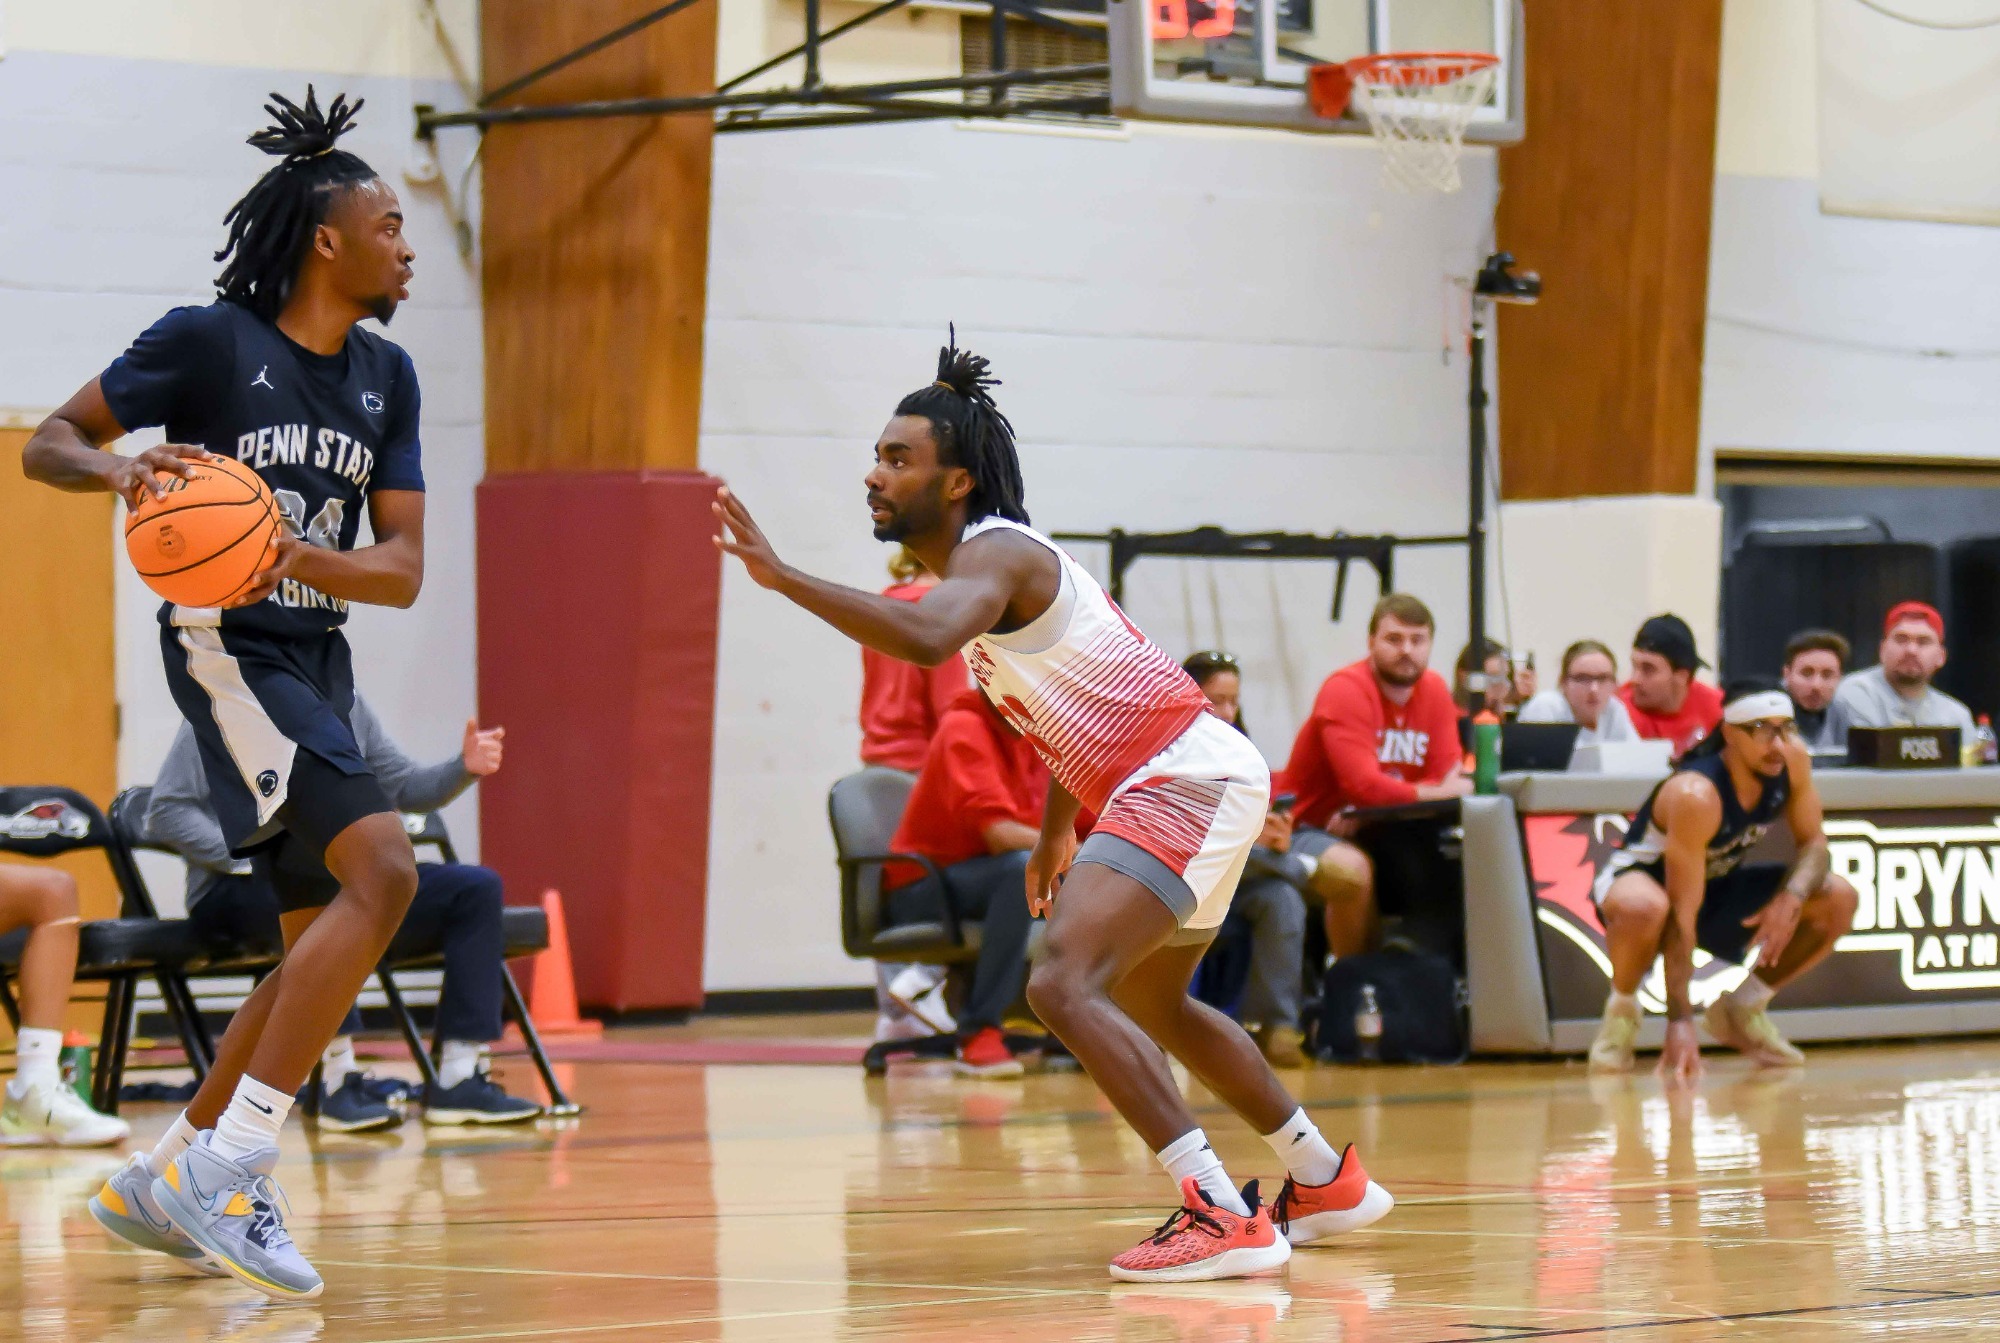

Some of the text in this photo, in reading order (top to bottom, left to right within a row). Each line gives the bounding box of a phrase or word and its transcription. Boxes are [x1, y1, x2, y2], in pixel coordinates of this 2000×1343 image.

[237, 423, 308, 469] PENN
[1828, 841, 2000, 930] BRYN
[1917, 933, 1998, 969] ATH
